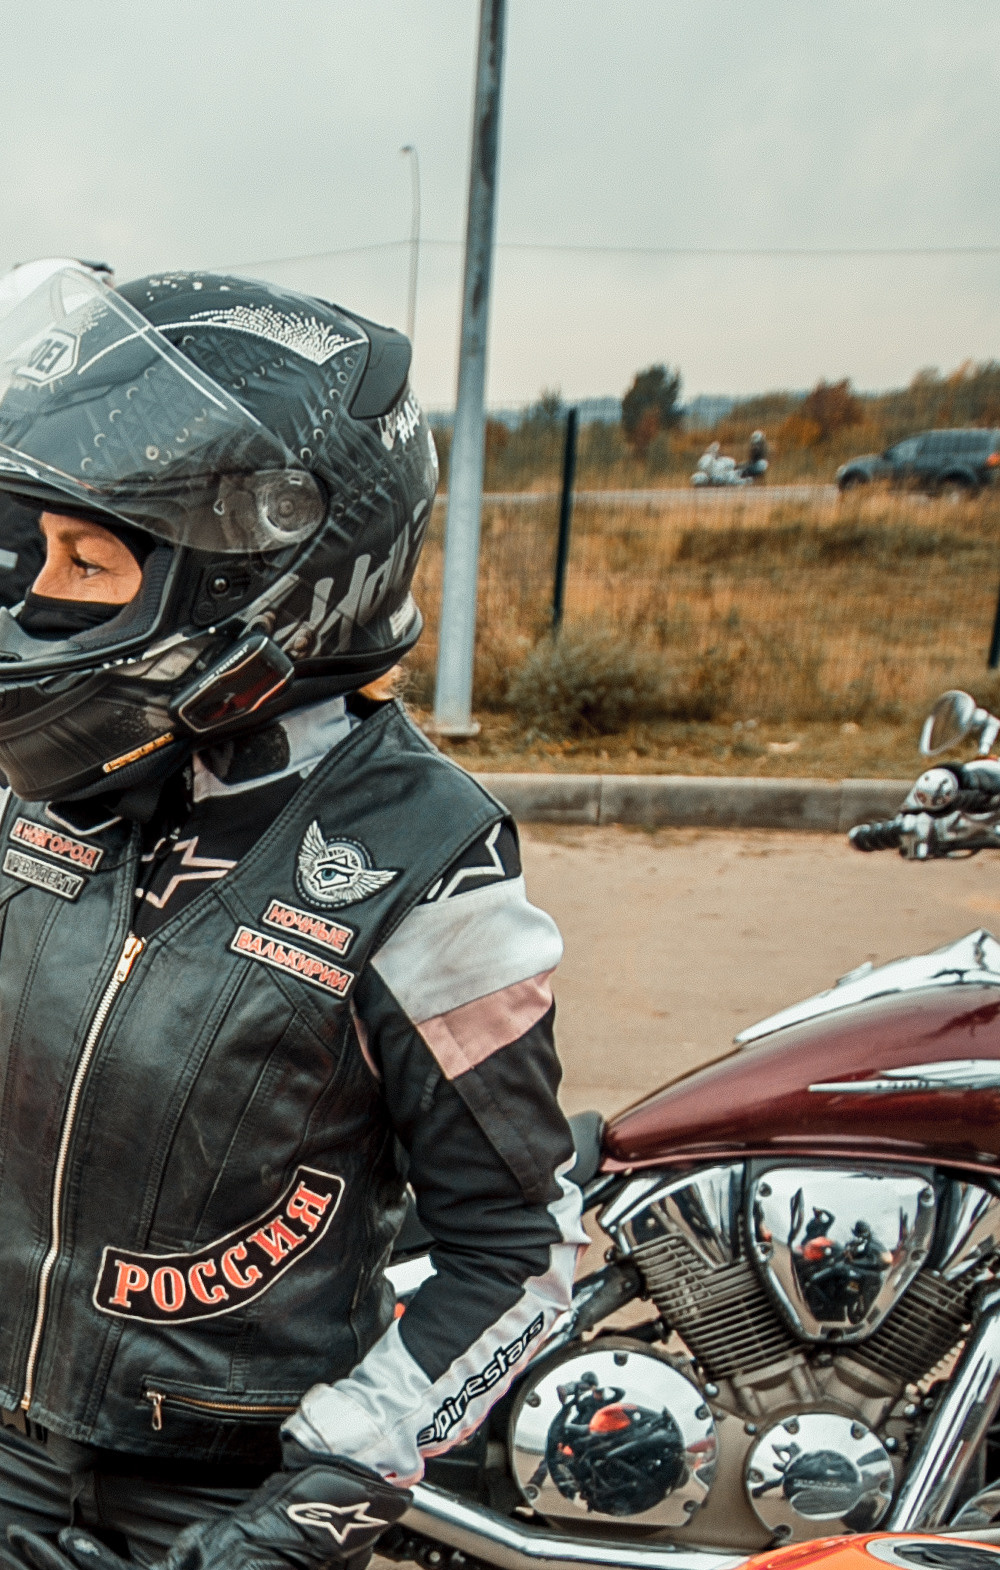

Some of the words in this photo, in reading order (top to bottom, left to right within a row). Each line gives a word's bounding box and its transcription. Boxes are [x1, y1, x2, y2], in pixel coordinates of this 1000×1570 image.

[237, 931, 349, 990] ВАЛЬКИРИИ
[268, 905, 349, 950] НОЧНЫЕ
[109, 1181, 332, 1312] РОССИЯ
[417, 1311, 544, 1447] alpinestars
